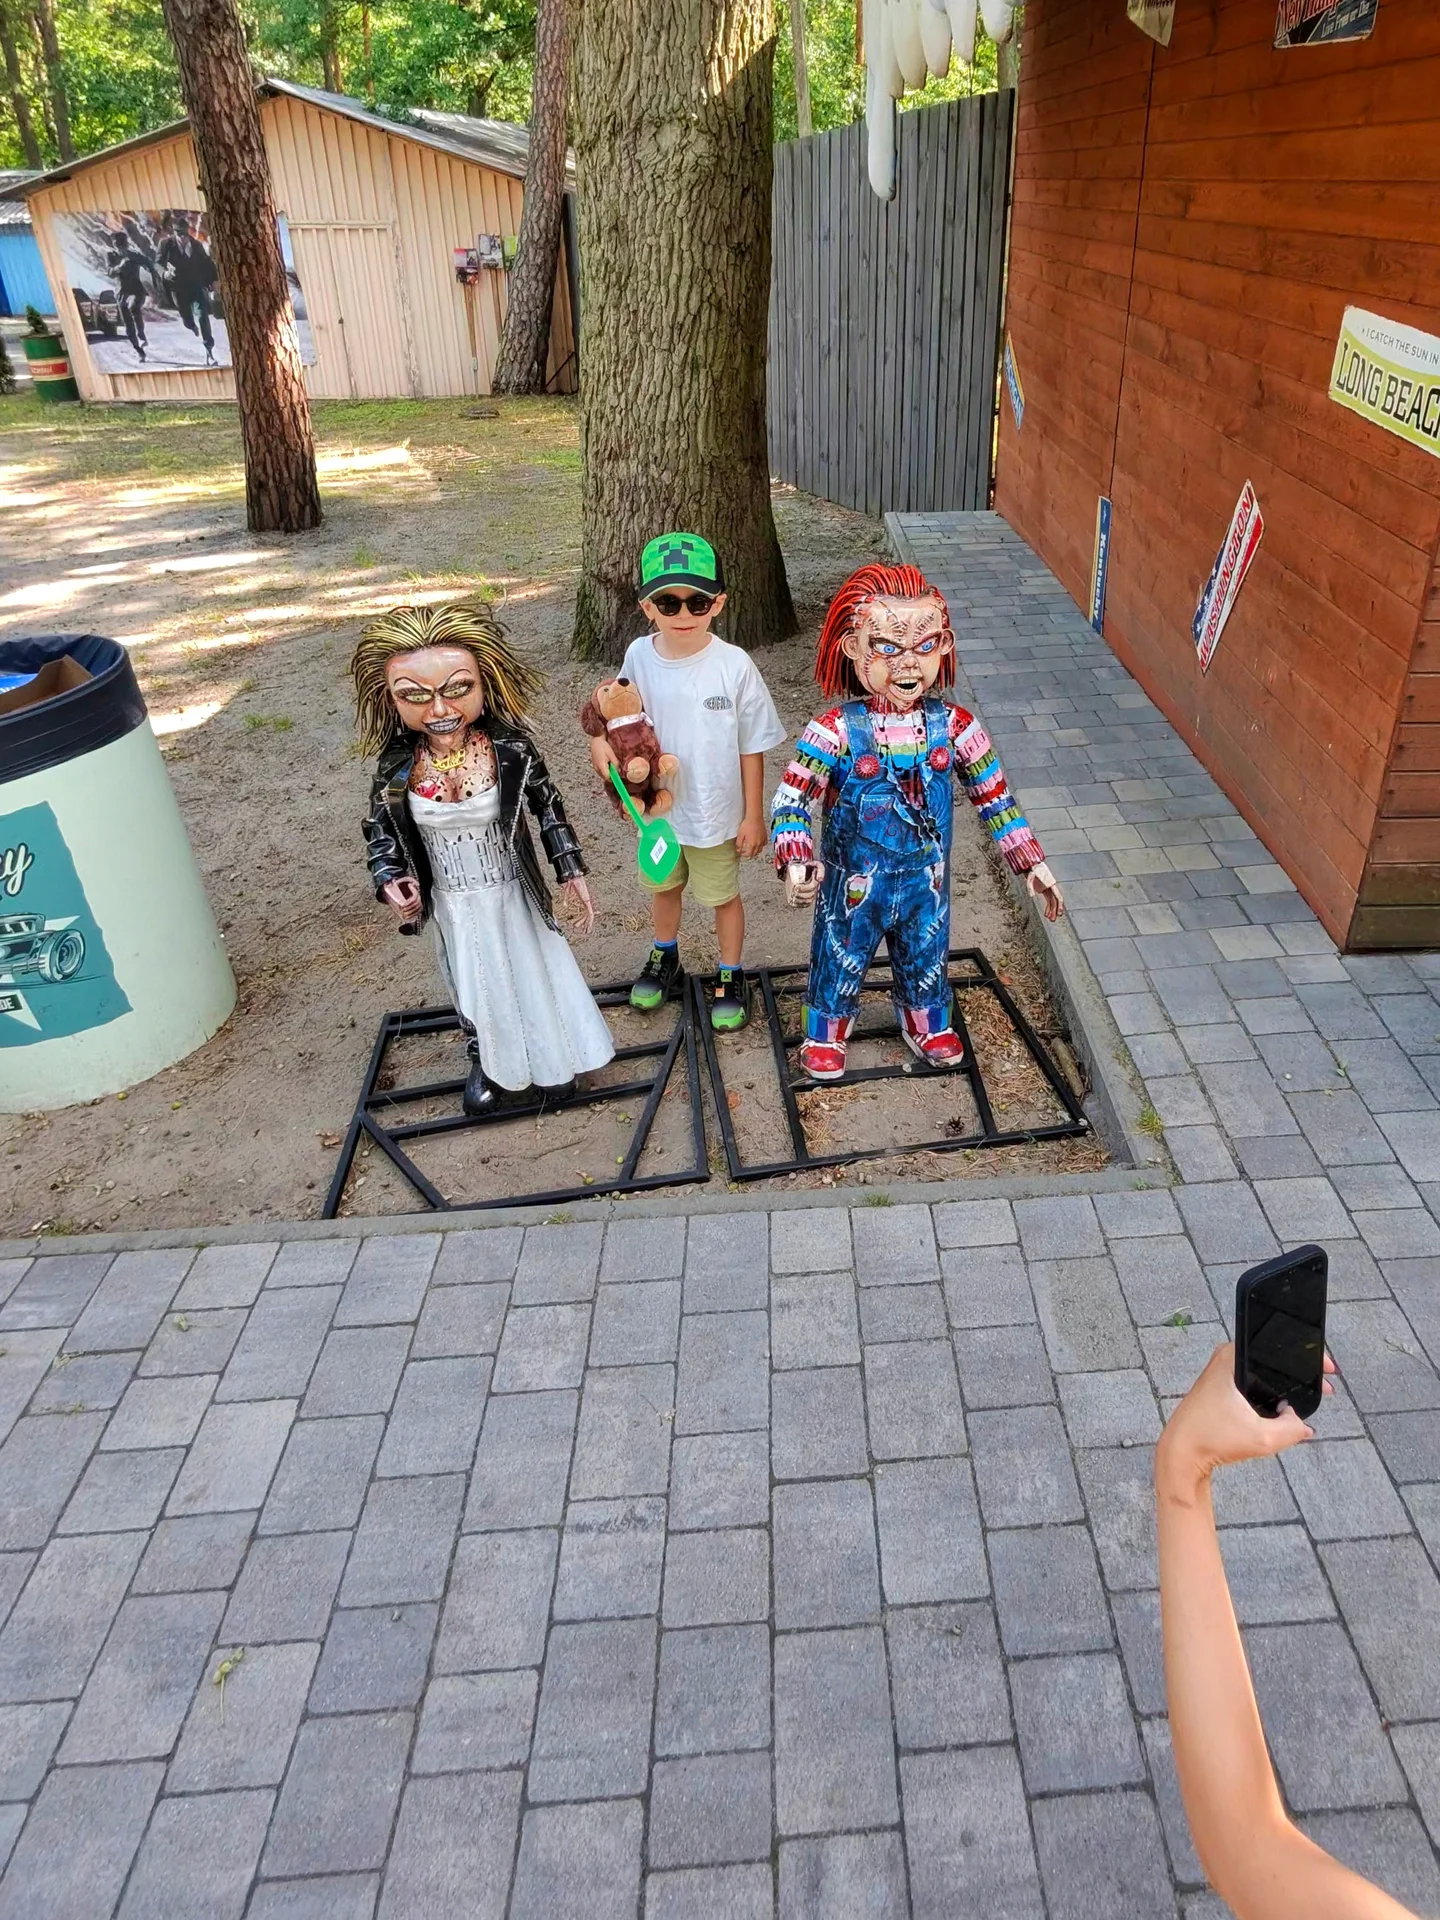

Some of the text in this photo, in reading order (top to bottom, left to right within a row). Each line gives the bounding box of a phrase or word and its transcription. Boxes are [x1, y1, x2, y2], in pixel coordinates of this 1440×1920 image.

[1321, 22, 1334, 38] Live
[1335, 14, 1349, 31] Free
[1336, 341, 1440, 439] LONG BEAC
[1370, 329, 1395, 347] CATCH
[1396, 339, 1411, 354] THE
[1411, 345, 1429, 361] SUN
[1430, 352, 1439, 364] IN
[1093, 531, 1107, 621] Kentucky
[1200, 493, 1253, 664] WASHINGTON
